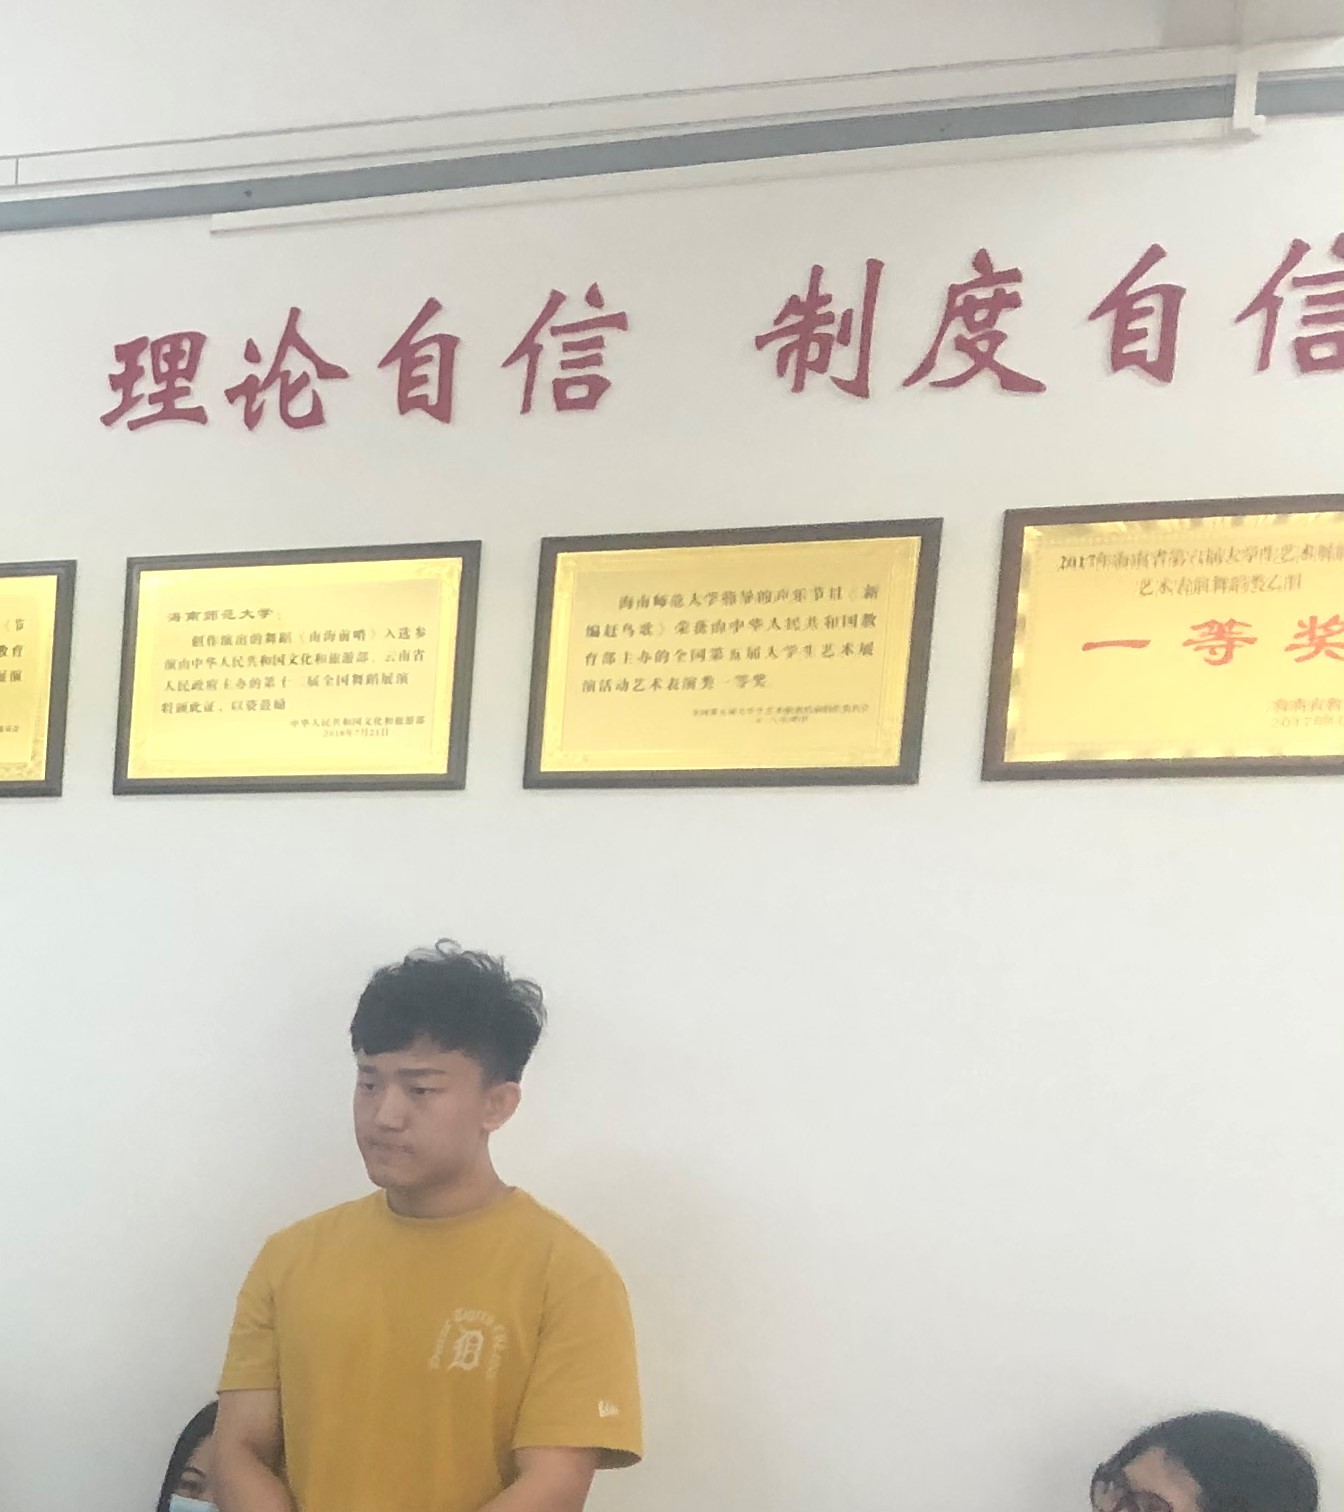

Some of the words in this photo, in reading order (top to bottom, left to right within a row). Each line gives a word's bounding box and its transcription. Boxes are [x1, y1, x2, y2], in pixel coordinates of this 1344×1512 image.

[100, 282, 629, 431] 理论自信
[755, 232, 1344, 399] 制度自信
[1082, 614, 1344, 666] 一等奖
